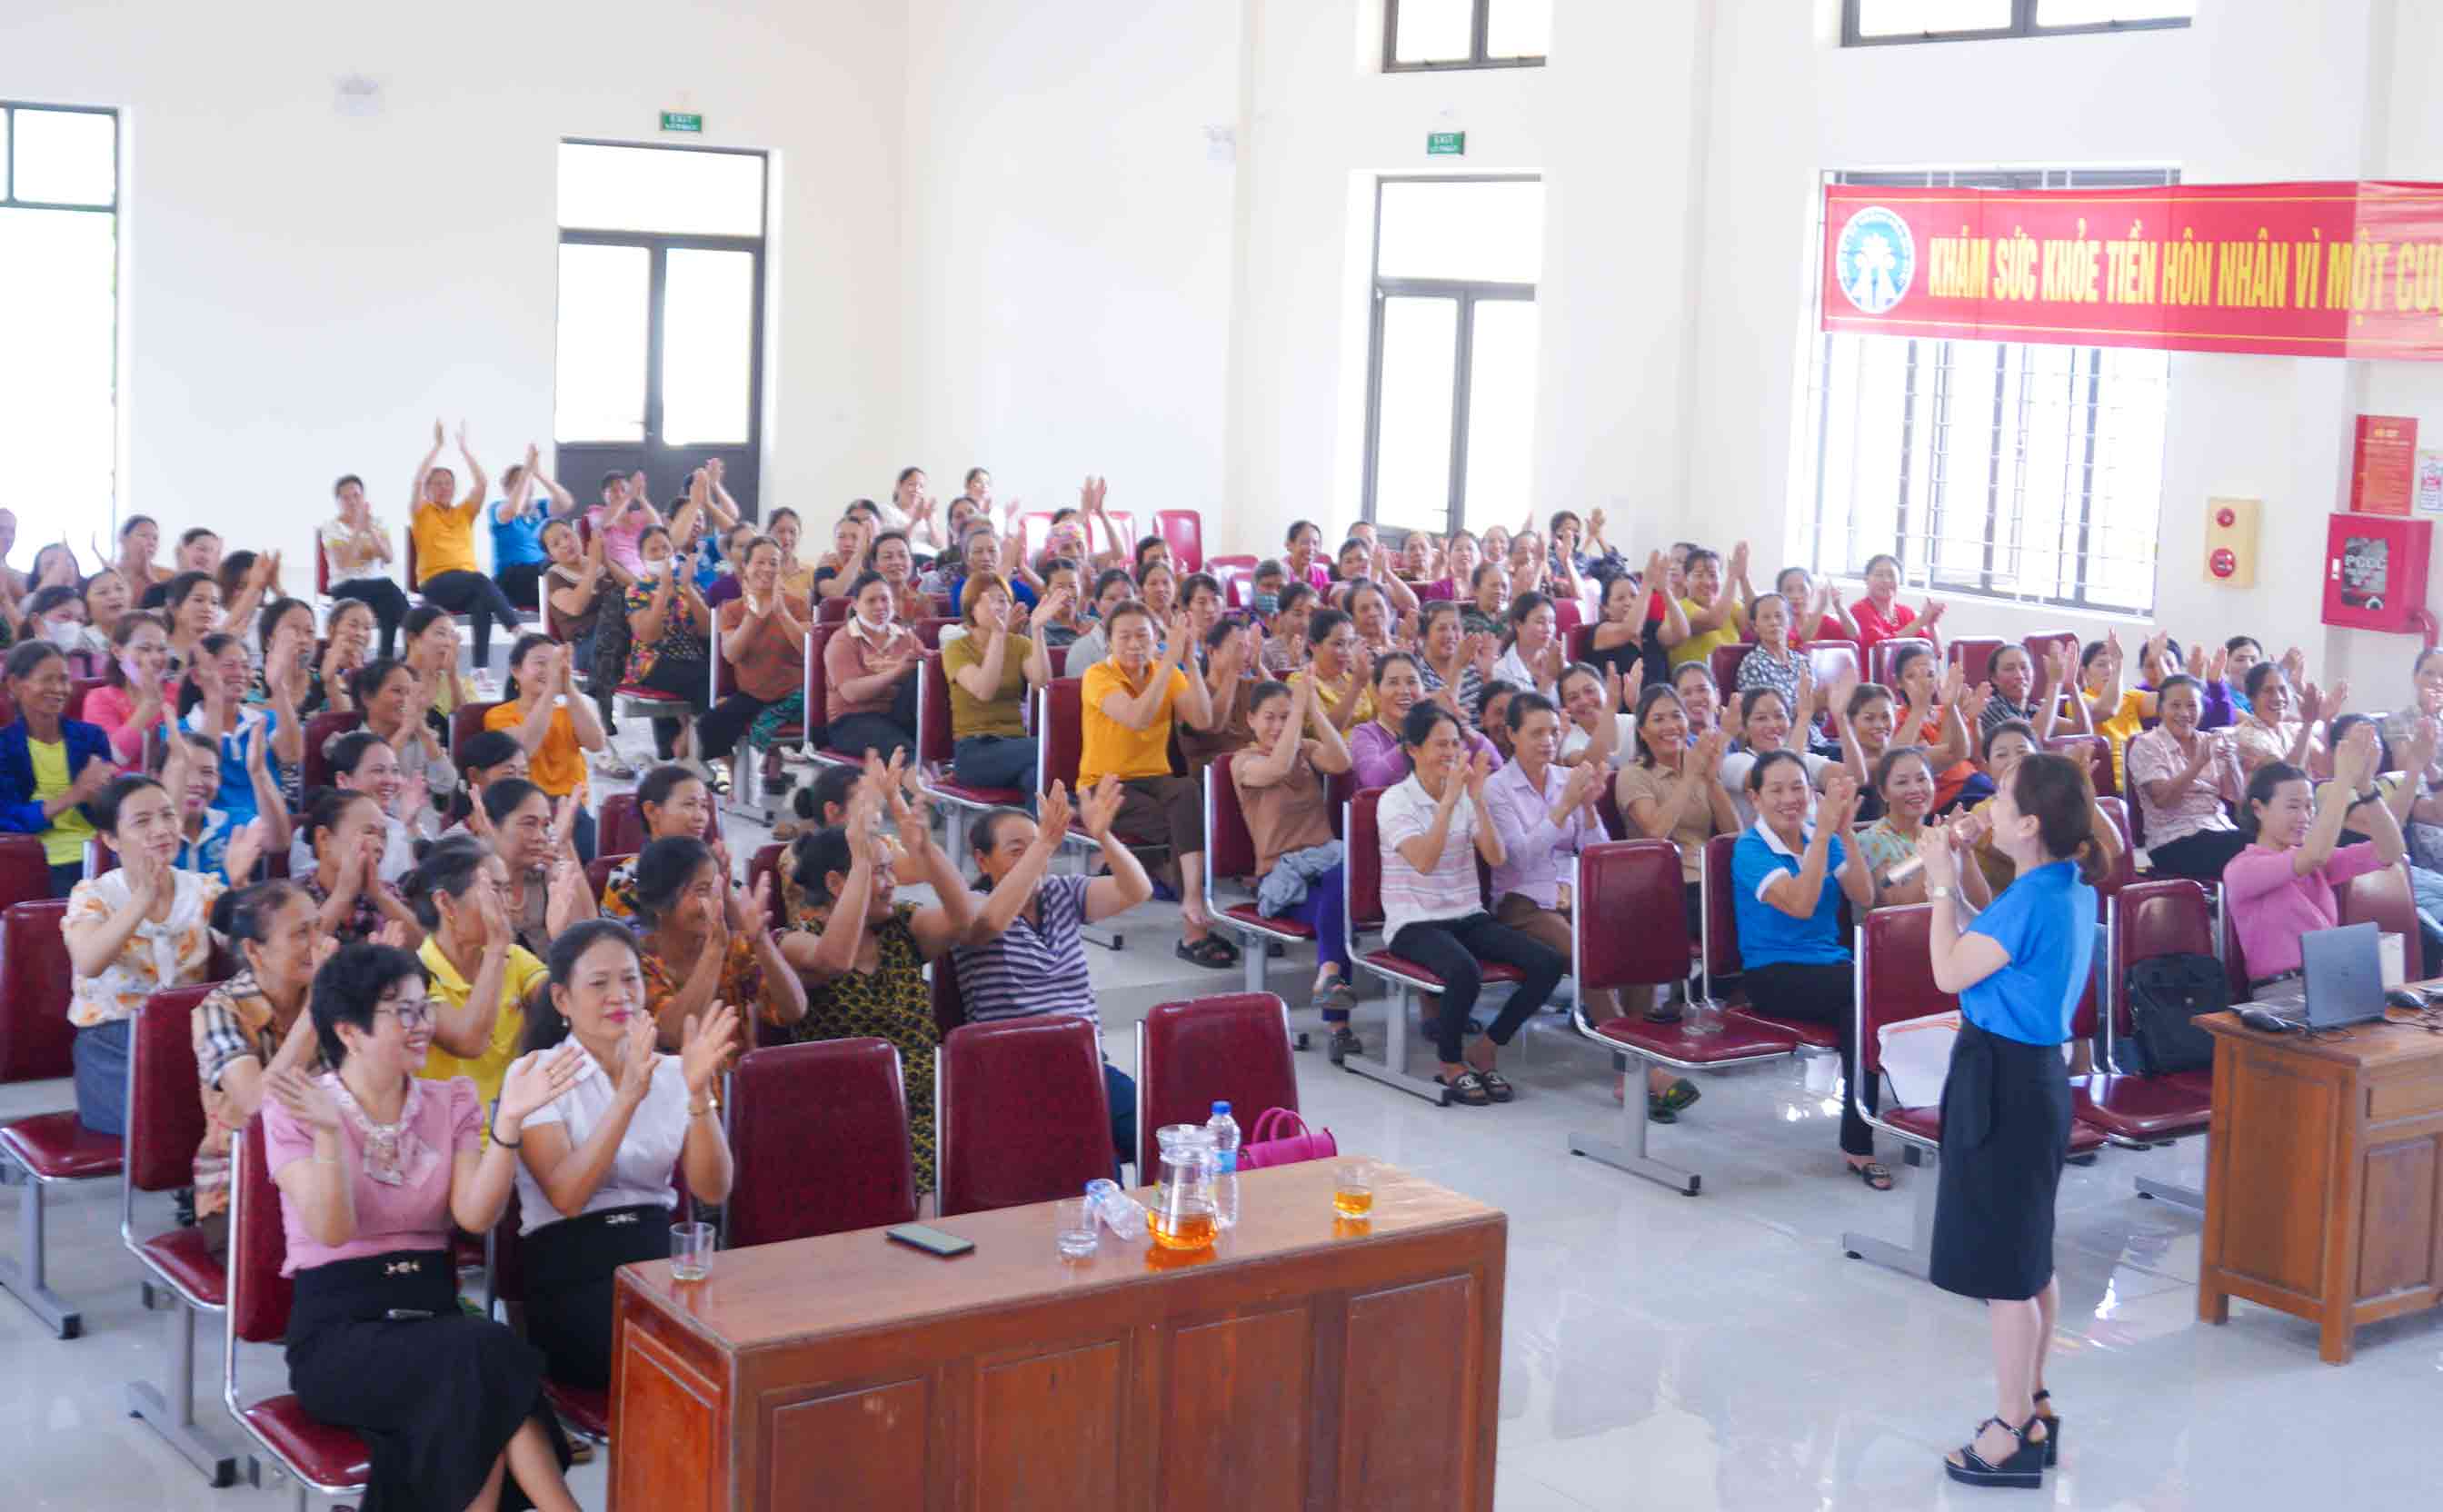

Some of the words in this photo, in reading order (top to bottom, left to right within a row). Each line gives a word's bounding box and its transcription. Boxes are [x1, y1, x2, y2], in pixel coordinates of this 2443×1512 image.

[1929, 224, 1990, 298] KHÁM
[1992, 225, 2039, 302] SỨC
[2041, 217, 2101, 303] KHỎE
[2162, 226, 2214, 306] HÔN
[2218, 226, 2289, 308] NHÂN
[2295, 227, 2321, 309] VÌ
[2326, 227, 2390, 327] MỘT
